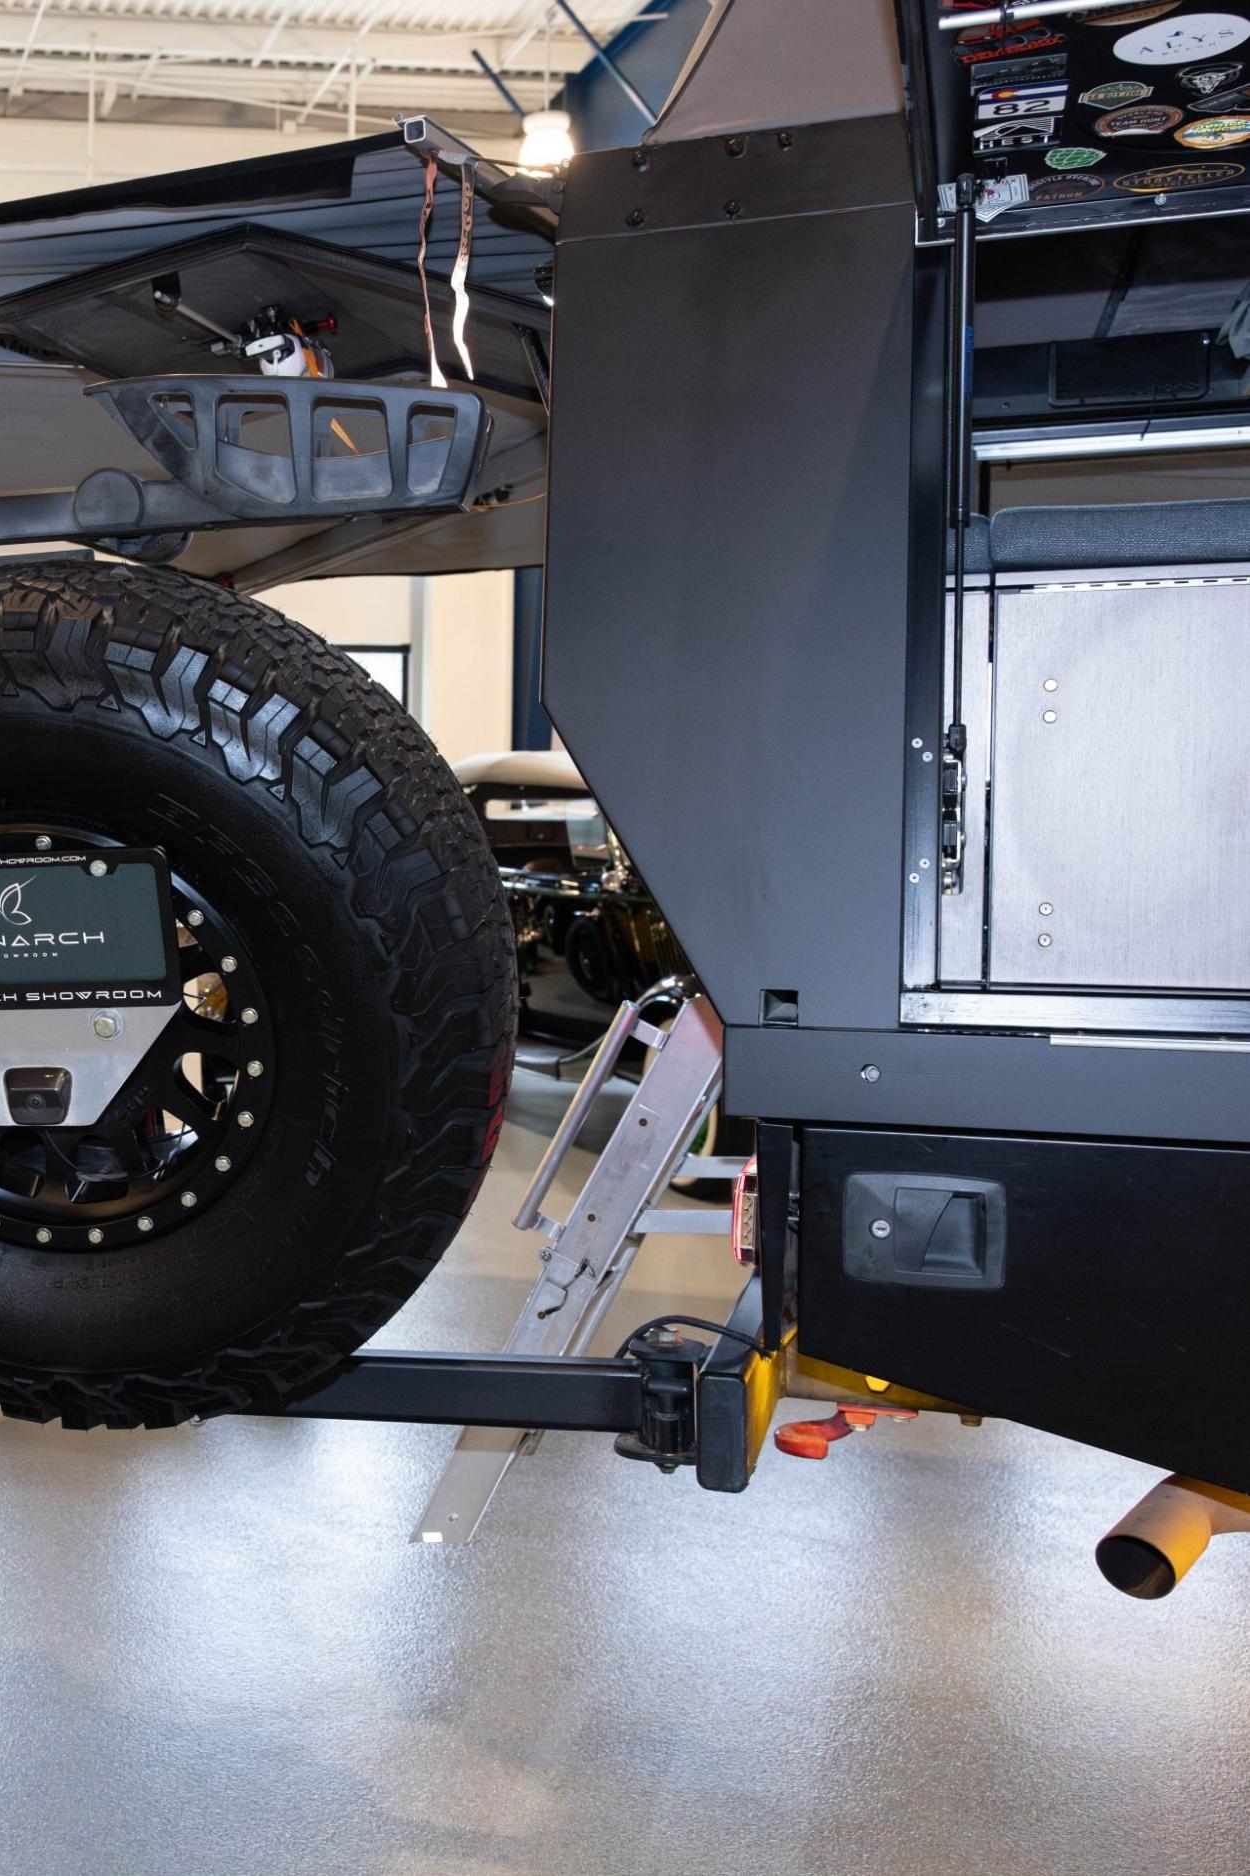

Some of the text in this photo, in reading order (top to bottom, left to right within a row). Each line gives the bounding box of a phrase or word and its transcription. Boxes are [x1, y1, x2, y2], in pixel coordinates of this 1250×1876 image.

[992, 99, 1051, 116] 82
[979, 135, 1049, 150] HEST
[25, 989, 162, 1002] SHOWROOM
